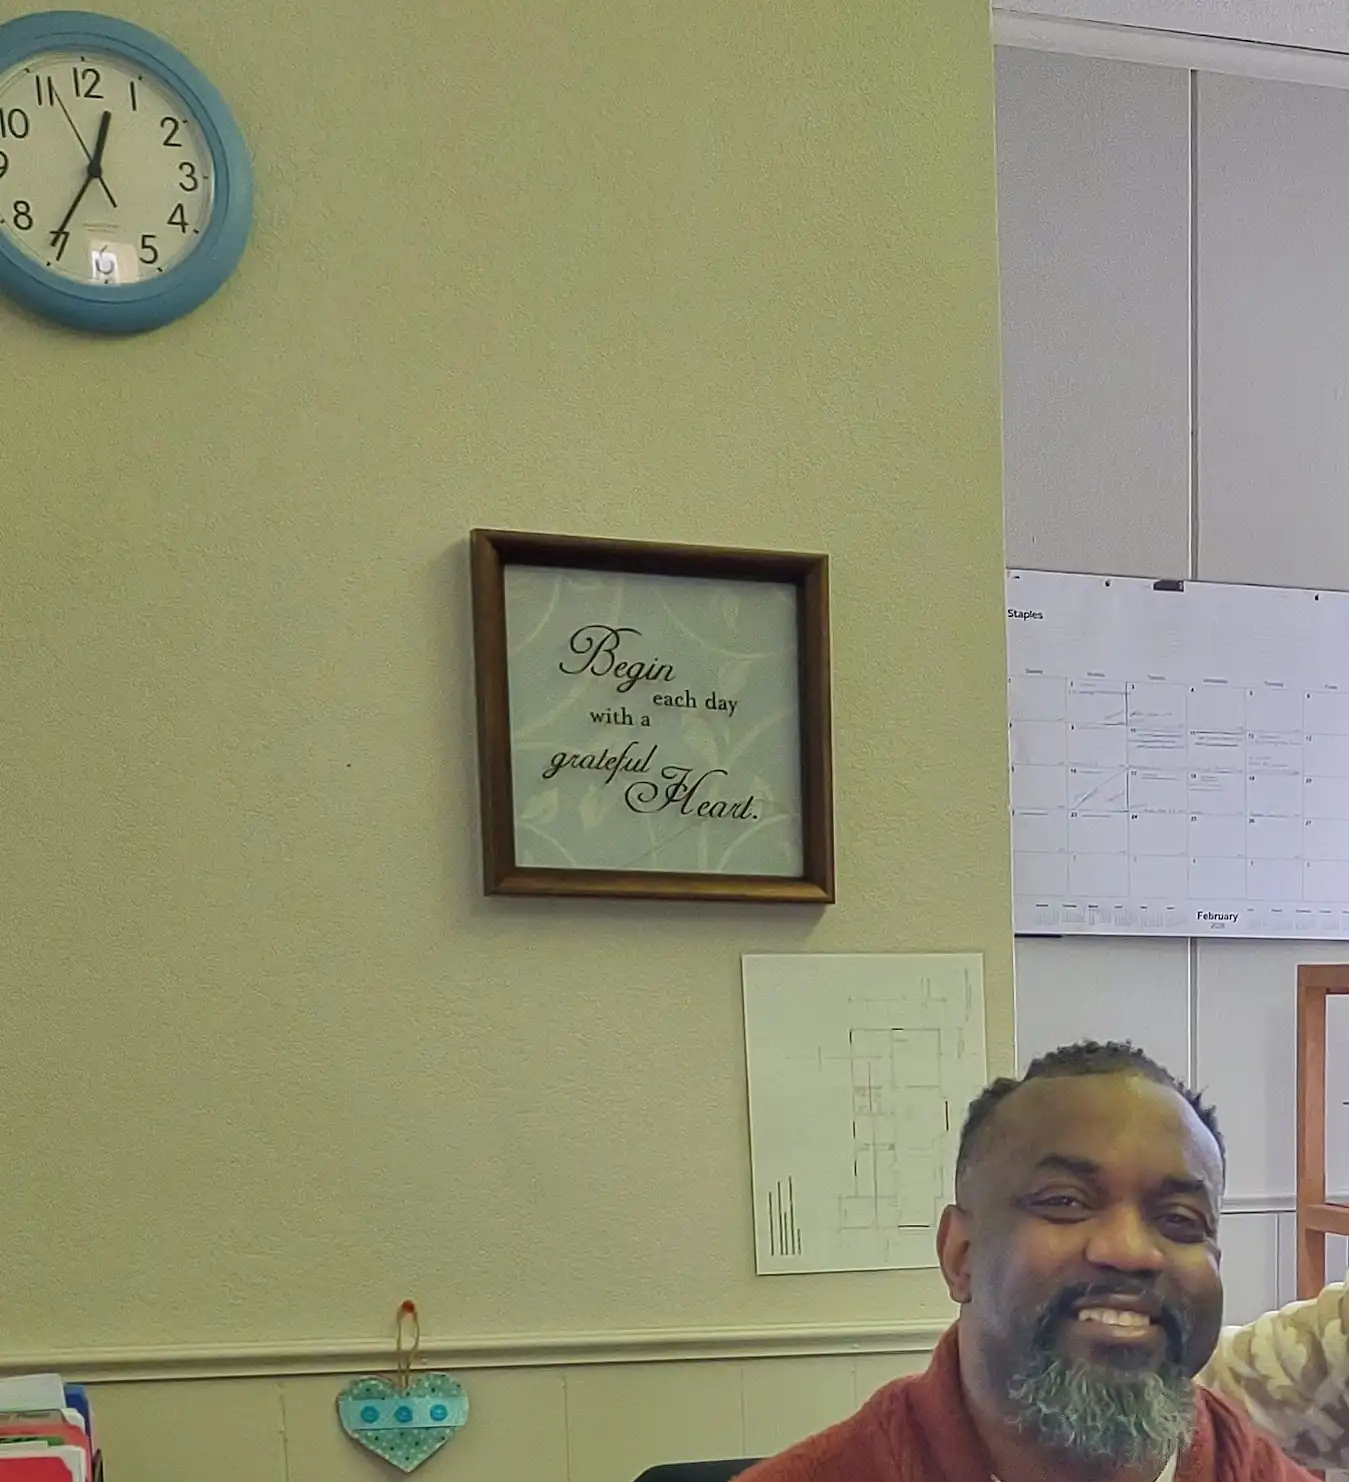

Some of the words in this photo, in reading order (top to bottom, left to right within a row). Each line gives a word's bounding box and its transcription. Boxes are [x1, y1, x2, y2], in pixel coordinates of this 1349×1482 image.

[35, 75, 54, 107] 11
[72, 67, 104, 99] 12
[129, 80, 138, 112] 1
[0, 107, 29, 139] 10
[159, 116, 182, 148] 2
[178, 161, 198, 192] 3
[12, 200, 33, 230] 8
[167, 202, 189, 234] 4
[49, 230, 70, 262] 7
[139, 233, 159, 265] 5
[1007, 609, 1044, 621] Staples
[558, 624, 676, 693] Begin
[589, 707, 633, 726] with
[640, 715, 651, 728] a
[652, 690, 697, 709] each
[705, 691, 738, 718] day
[542, 740, 658, 784] grateful
[624, 765, 759, 821] Heart.
[1197, 911, 1239, 923] February
